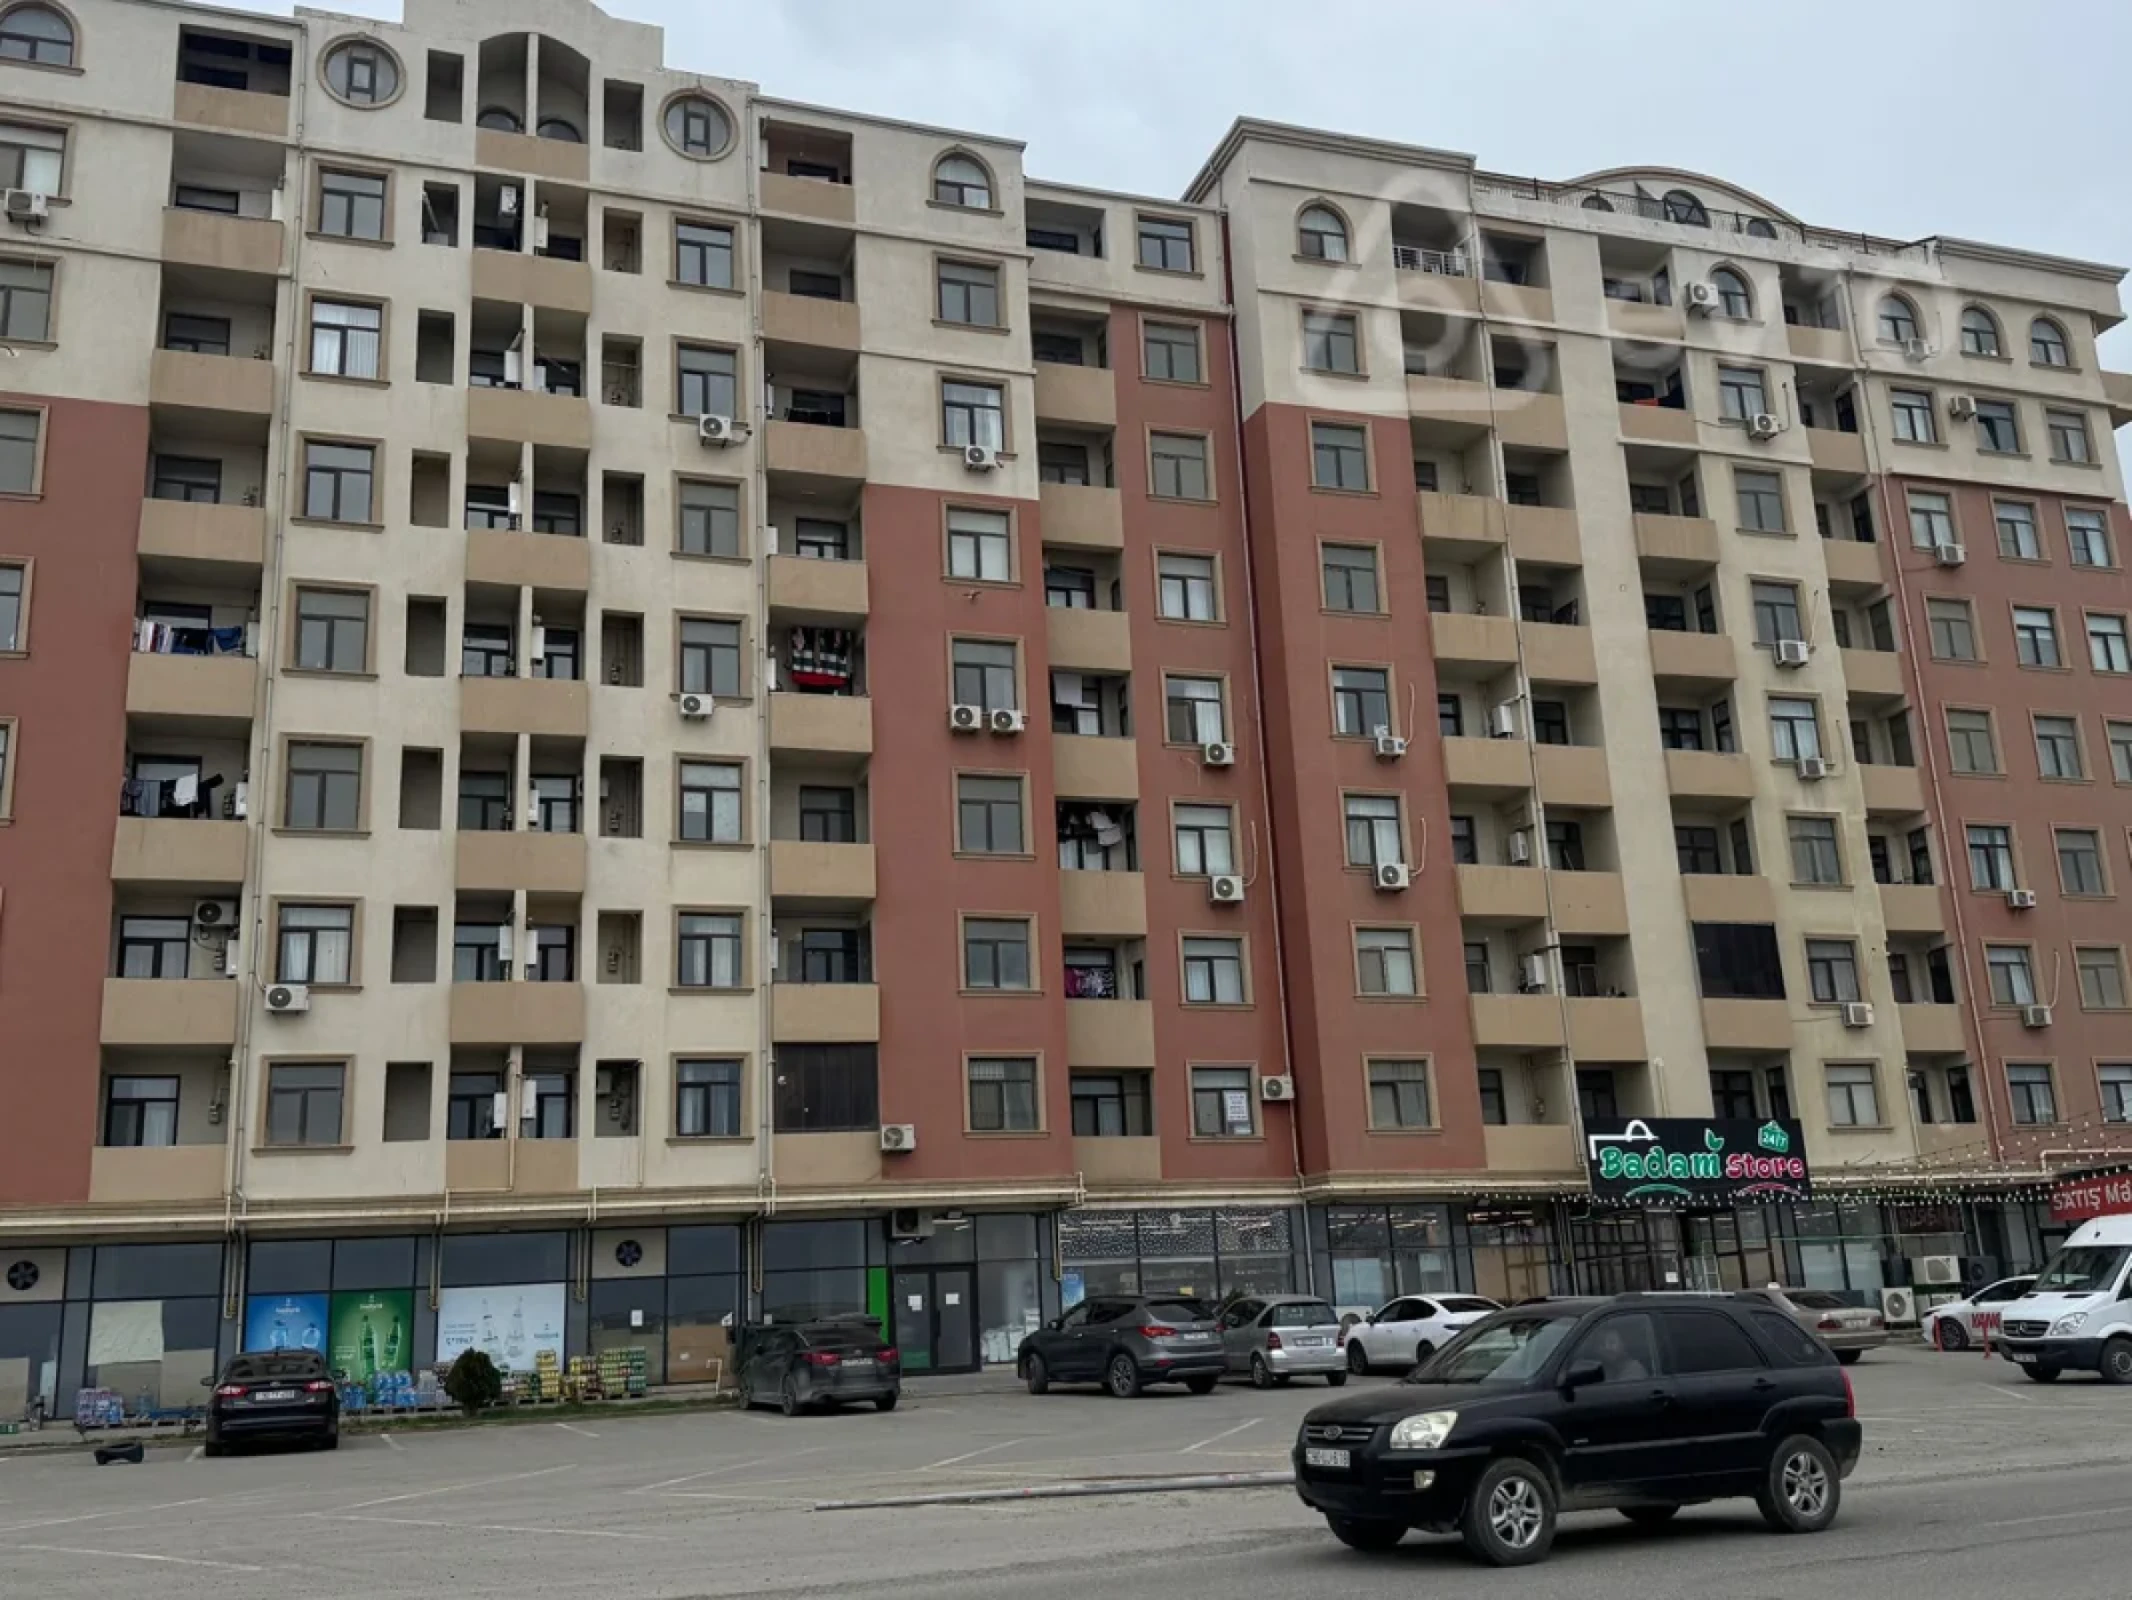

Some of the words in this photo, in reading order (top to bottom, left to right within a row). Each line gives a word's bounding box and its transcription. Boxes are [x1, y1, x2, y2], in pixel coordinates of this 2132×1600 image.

[1761, 1131, 1787, 1148] 24/7
[1600, 1146, 1721, 1179] Badam
[2052, 1187, 2101, 1211] SATIŞ
